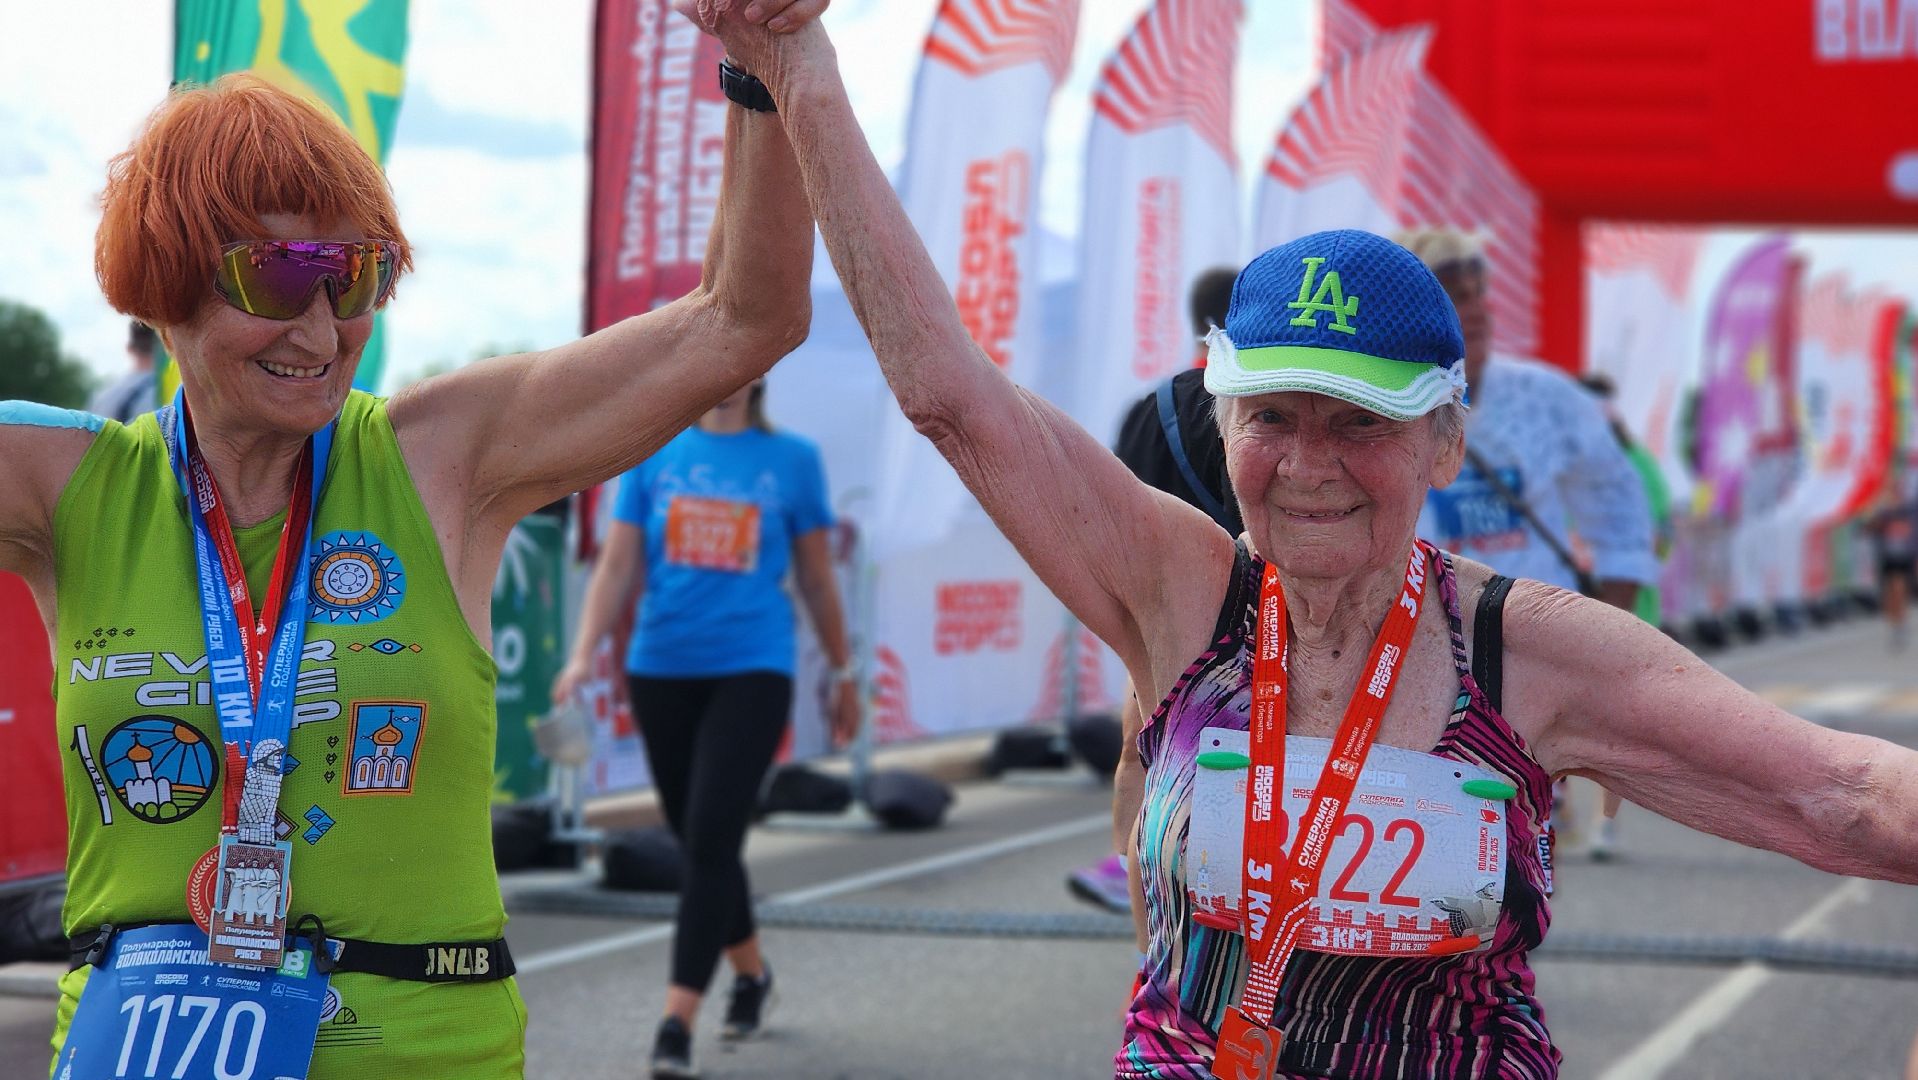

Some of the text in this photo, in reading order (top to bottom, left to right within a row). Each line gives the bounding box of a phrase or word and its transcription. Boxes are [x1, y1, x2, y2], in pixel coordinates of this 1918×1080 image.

[955, 160, 996, 345] СОБЛ
[987, 214, 1024, 368] ПОРТ
[1288, 257, 1359, 335] LA
[1400, 590, 1417, 619] 3
[207, 613, 225, 650] РУБЕЖ
[1262, 598, 1270, 661] ПОДМОСКОВЬЯ
[1269, 595, 1279, 661] СУПЕРЛИГА
[70, 639, 340, 684] NEVR
[212, 655, 245, 684] 10
[271, 621, 293, 688] СУПЕРЛИГА
[280, 620, 299, 687] ПОДМОСКОВЬЯ
[1367, 643, 1393, 696] МОСОБЛ
[135, 668, 338, 708] GIE
[1375, 659, 1396, 699] СПОРТ
[1256, 701, 1266, 743] Губернатора
[1267, 701, 1275, 730] Команда
[1343, 726, 1360, 756] Команда
[1351, 718, 1374, 759] Губернатора
[1253, 765, 1264, 808] СПОРТ
[1261, 766, 1275, 821] МОСОБЛ
[1359, 793, 1405, 803] СУПЕРЛИГА
[1299, 796, 1333, 867] СУПЕРЛИГА
[1308, 798, 1341, 870] ПОДМОСКОВЬЯ
[1248, 858, 1272, 882] 3
[1280, 808, 1425, 908] 22
[121, 938, 192, 953] Полумарафон
[225, 926, 274, 937] Полумарафон
[115, 948, 214, 969] ВОЛОКОЛАМСКИ
[216, 977, 262, 988] СУПЕРЛИГА
[115, 994, 267, 1080] 1170
